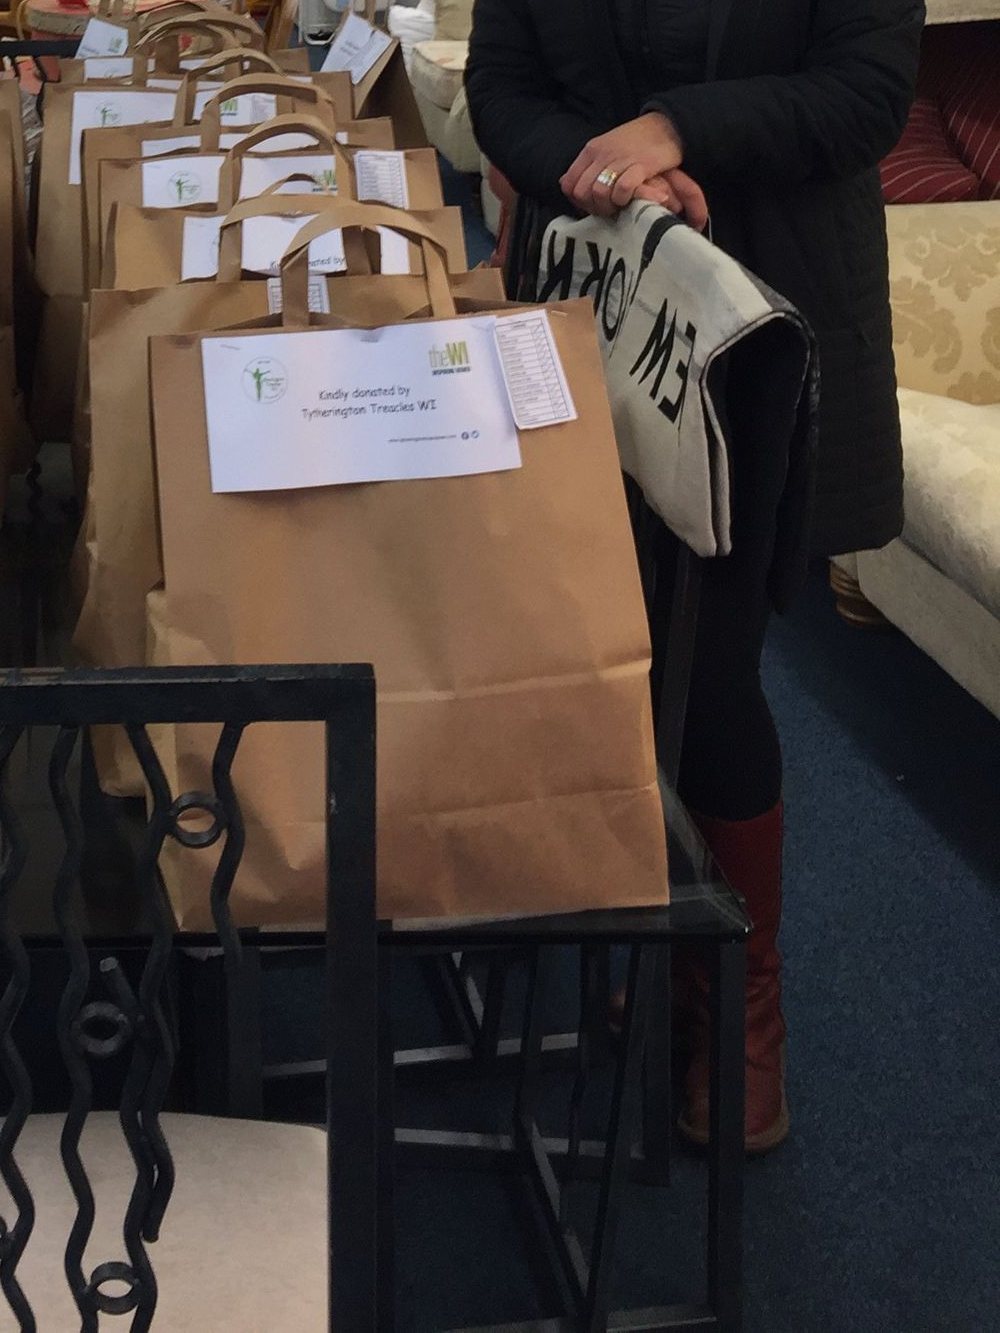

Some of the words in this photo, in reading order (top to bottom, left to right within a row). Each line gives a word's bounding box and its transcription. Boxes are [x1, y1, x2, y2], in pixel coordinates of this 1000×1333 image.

[319, 389, 349, 401] Kindly
[352, 386, 395, 398] donated
[398, 386, 410, 397] by
[302, 406, 366, 421] Tytherington
[369, 403, 415, 414] Treacles
